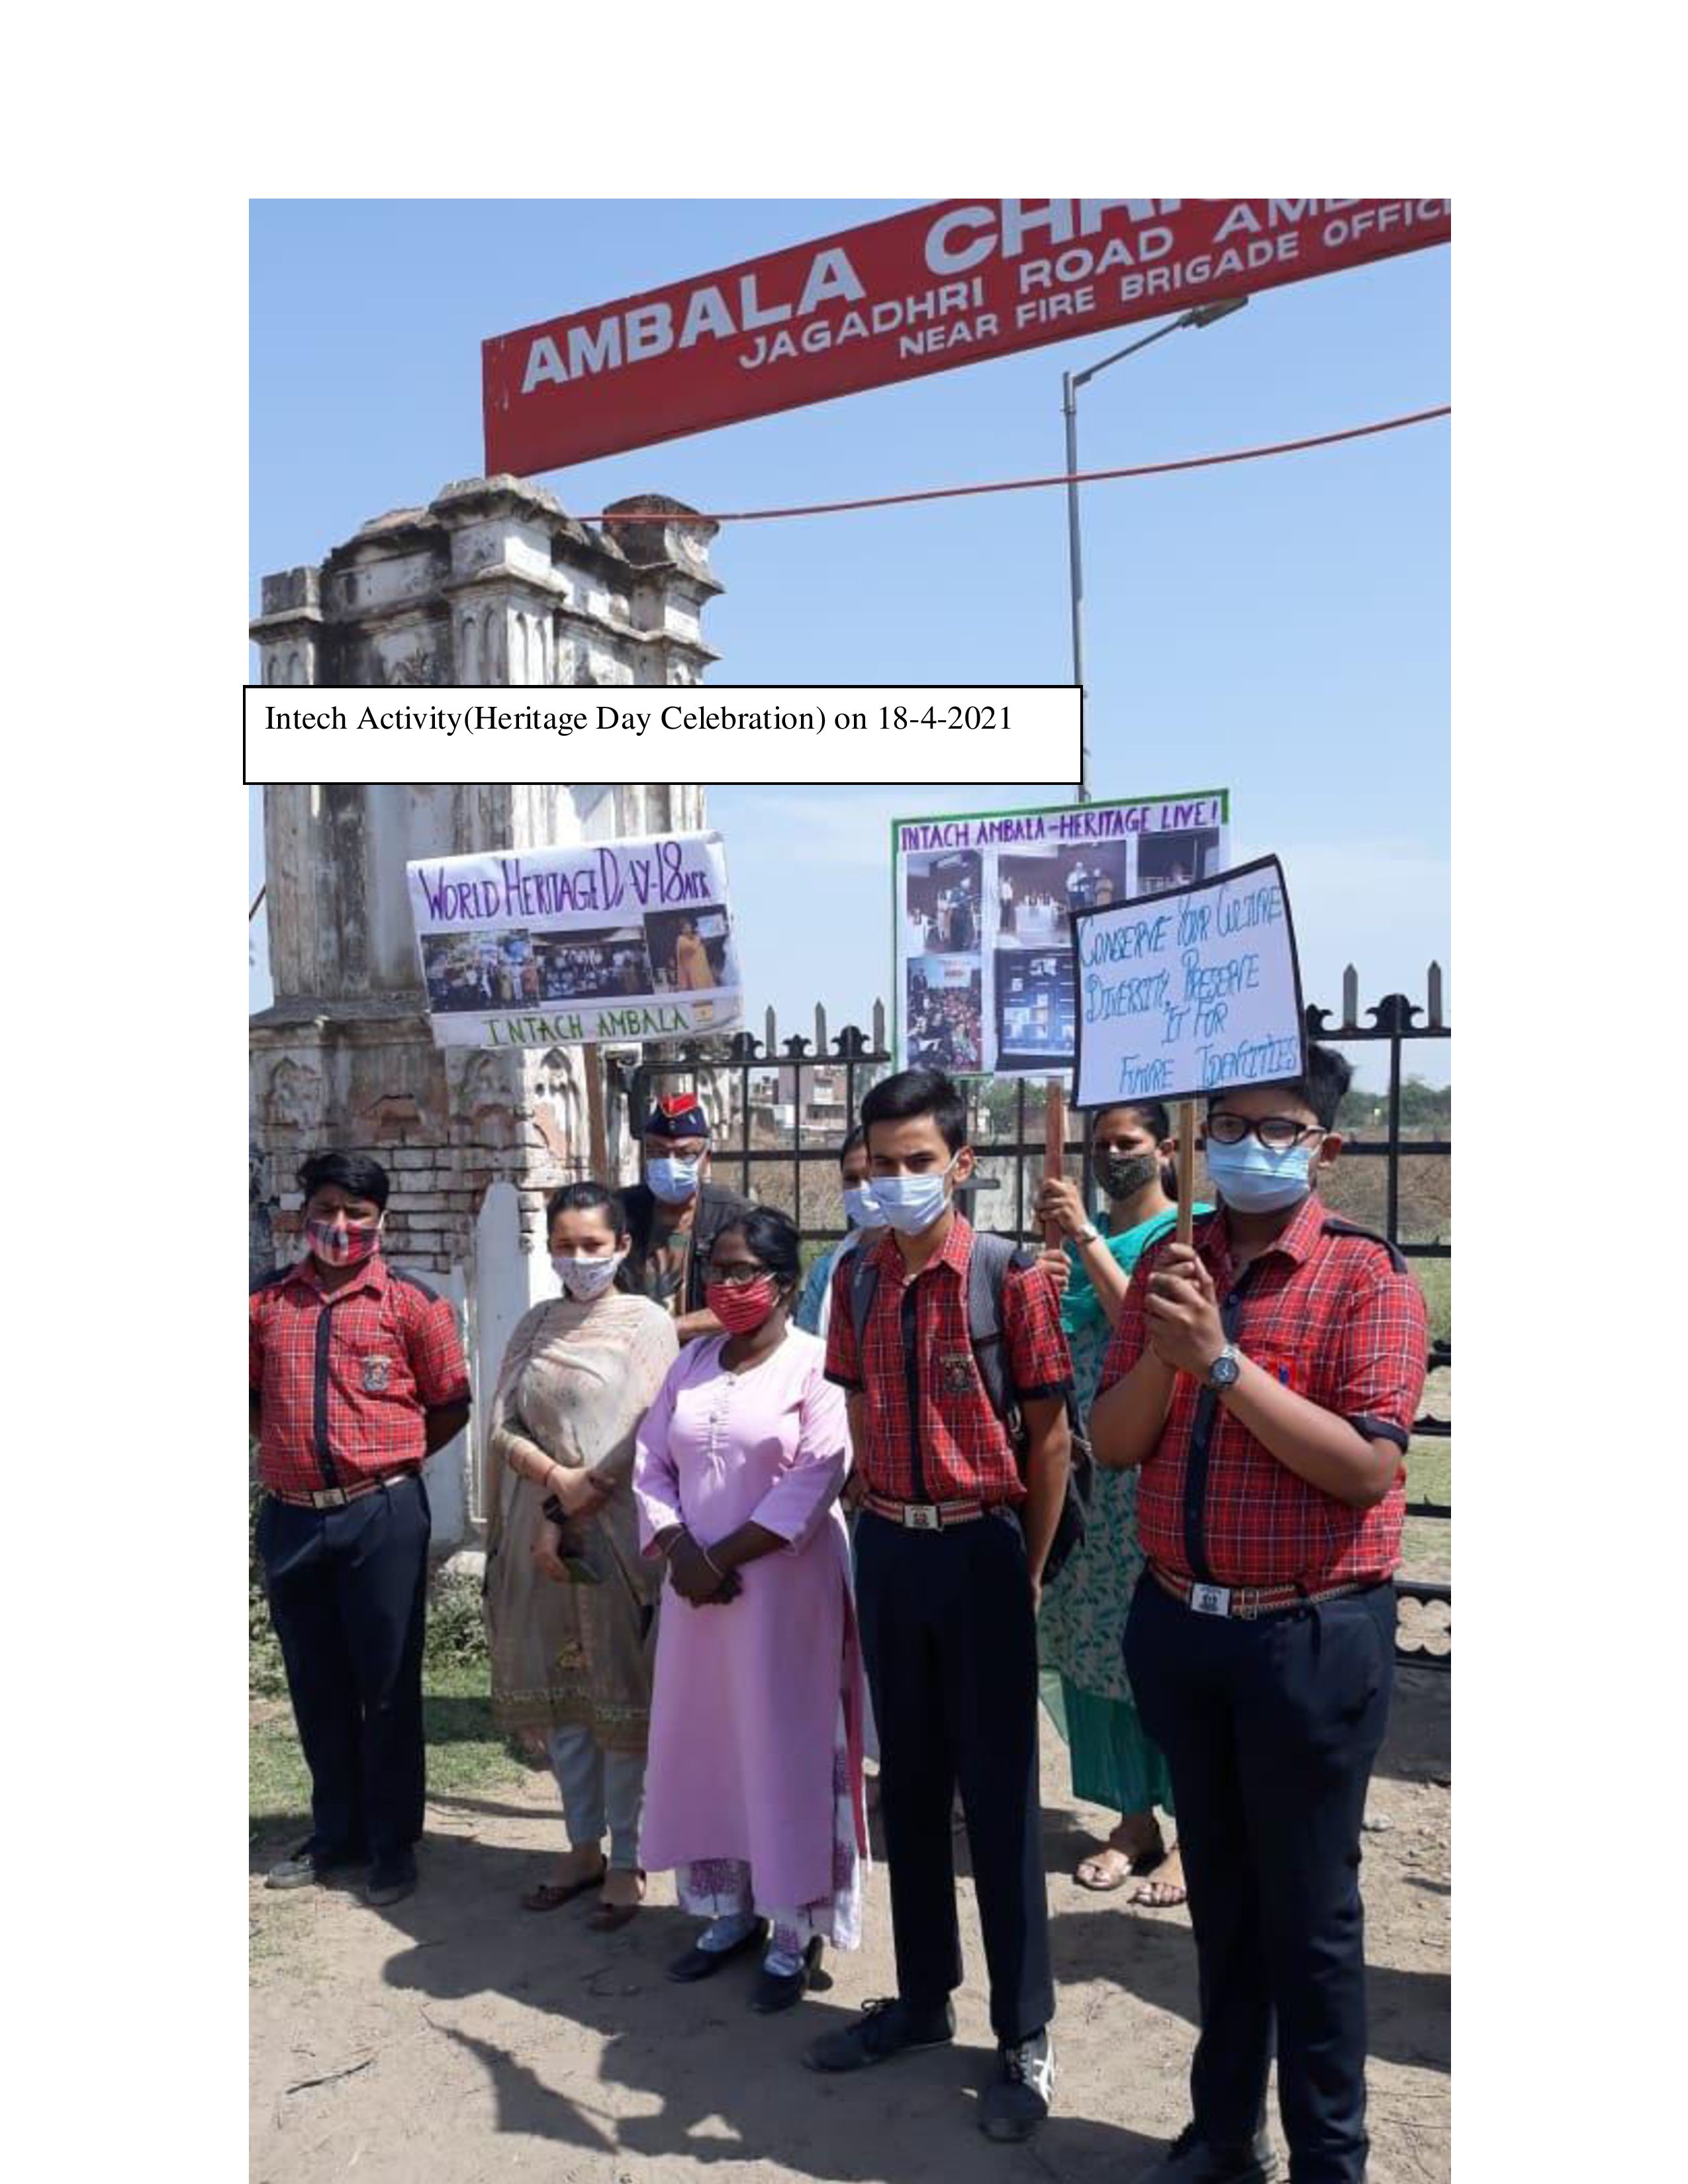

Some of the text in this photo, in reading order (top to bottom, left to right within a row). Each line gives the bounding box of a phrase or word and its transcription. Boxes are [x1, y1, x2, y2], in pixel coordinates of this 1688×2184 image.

[522, 248, 866, 393] AMBALA
[739, 276, 984, 369] JAGADHRI
[1019, 226, 1174, 295] ROAD
[900, 314, 998, 359] NEAR
[1015, 285, 1095, 329] FIRE
[1121, 232, 1299, 300] BRIGADE
[902, 823, 969, 852] INTACH
[1161, 800, 1218, 830] LIVE!
[419, 866, 500, 921] WORLD
[501, 858, 599, 917] HERITAGE
[1078, 916, 1172, 967] CONSERVE
[481, 1008, 689, 1046] INTACH AMBALA
[1194, 1001, 1229, 1038] FOR
